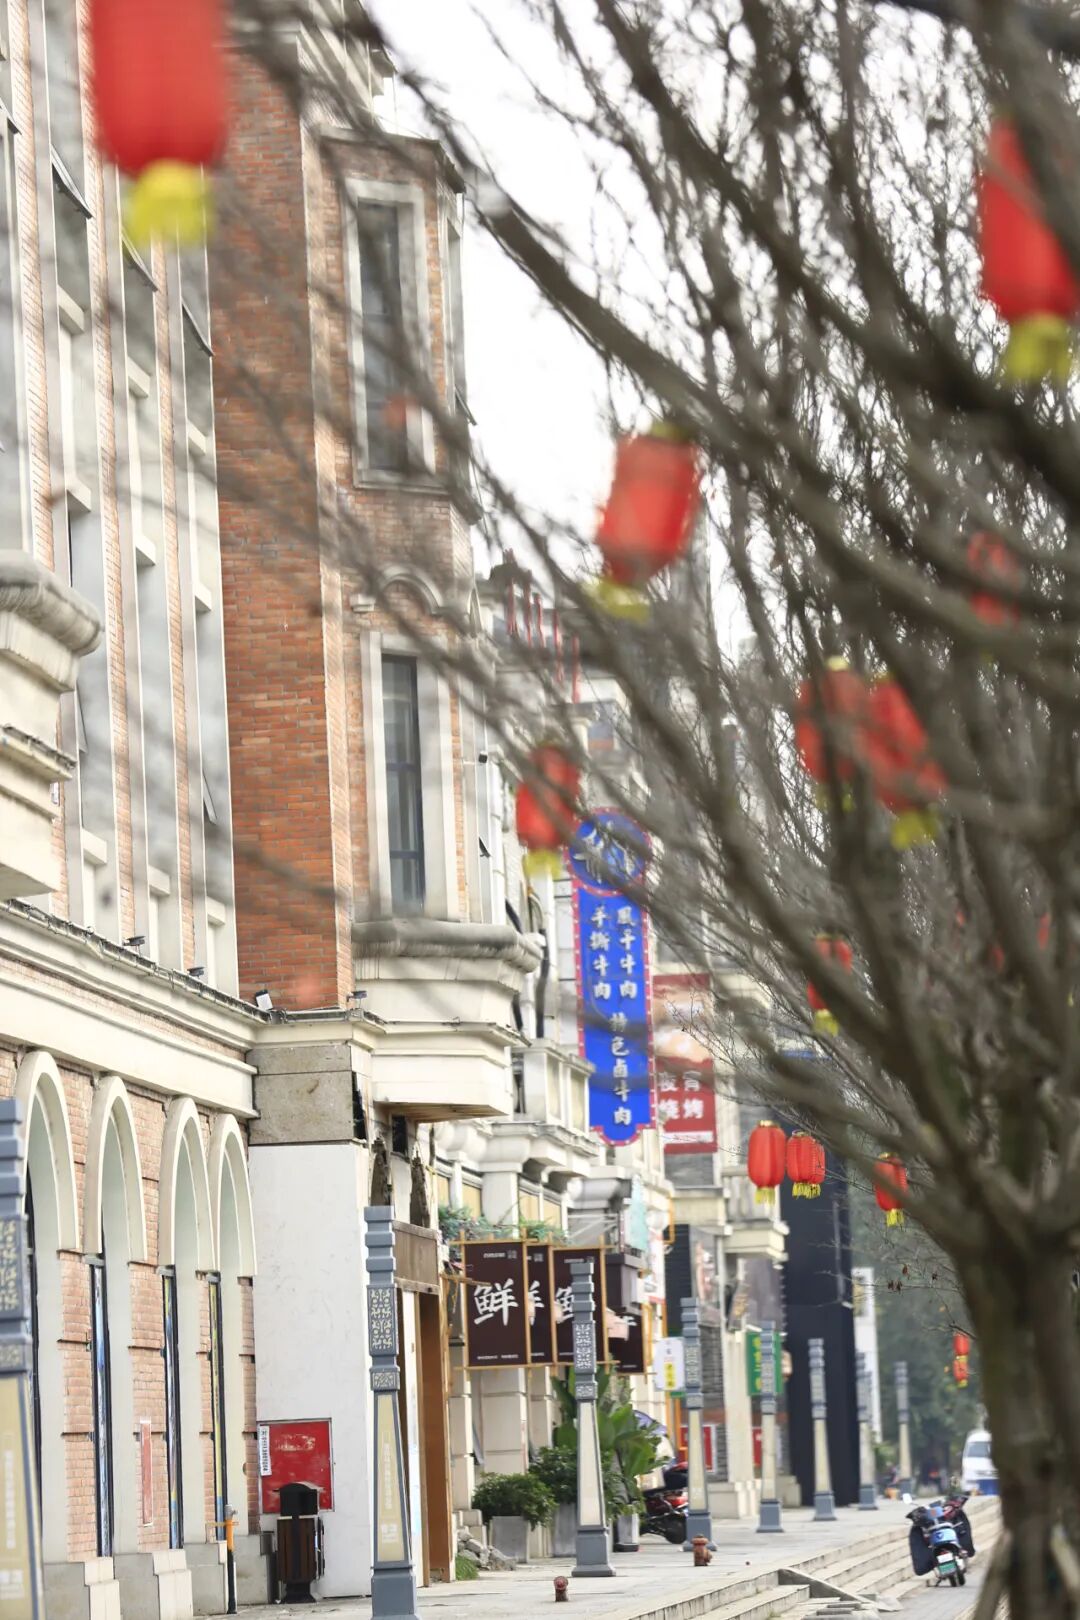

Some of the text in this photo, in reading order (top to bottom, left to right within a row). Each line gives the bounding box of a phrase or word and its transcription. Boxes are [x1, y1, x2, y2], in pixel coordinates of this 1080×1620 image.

[589, 905, 612, 1000] 手撕牛肉
[473, 1277, 519, 1327] 鲜
